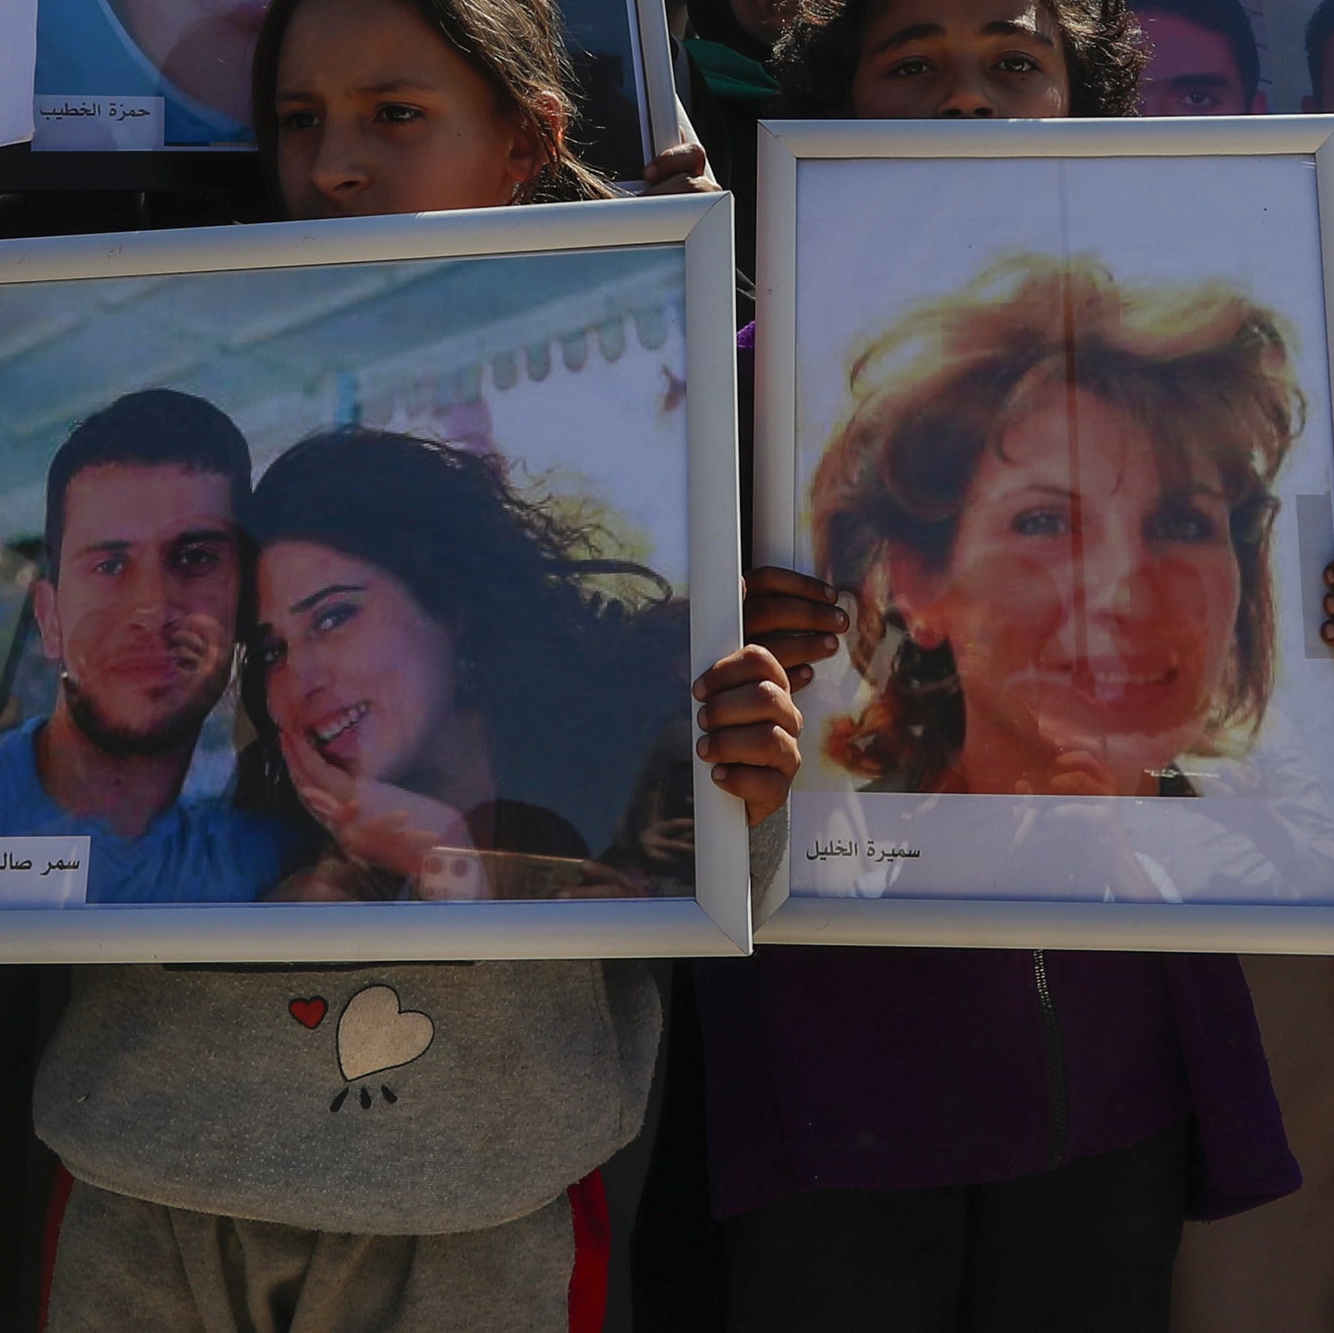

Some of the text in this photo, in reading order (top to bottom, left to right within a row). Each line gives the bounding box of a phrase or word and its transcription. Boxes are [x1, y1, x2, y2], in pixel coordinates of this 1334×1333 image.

[39, 102, 151, 121] حمزة الخطيب
[805, 840, 921, 862] سميرة الخليل
[39, 856, 80, 876] سمر
